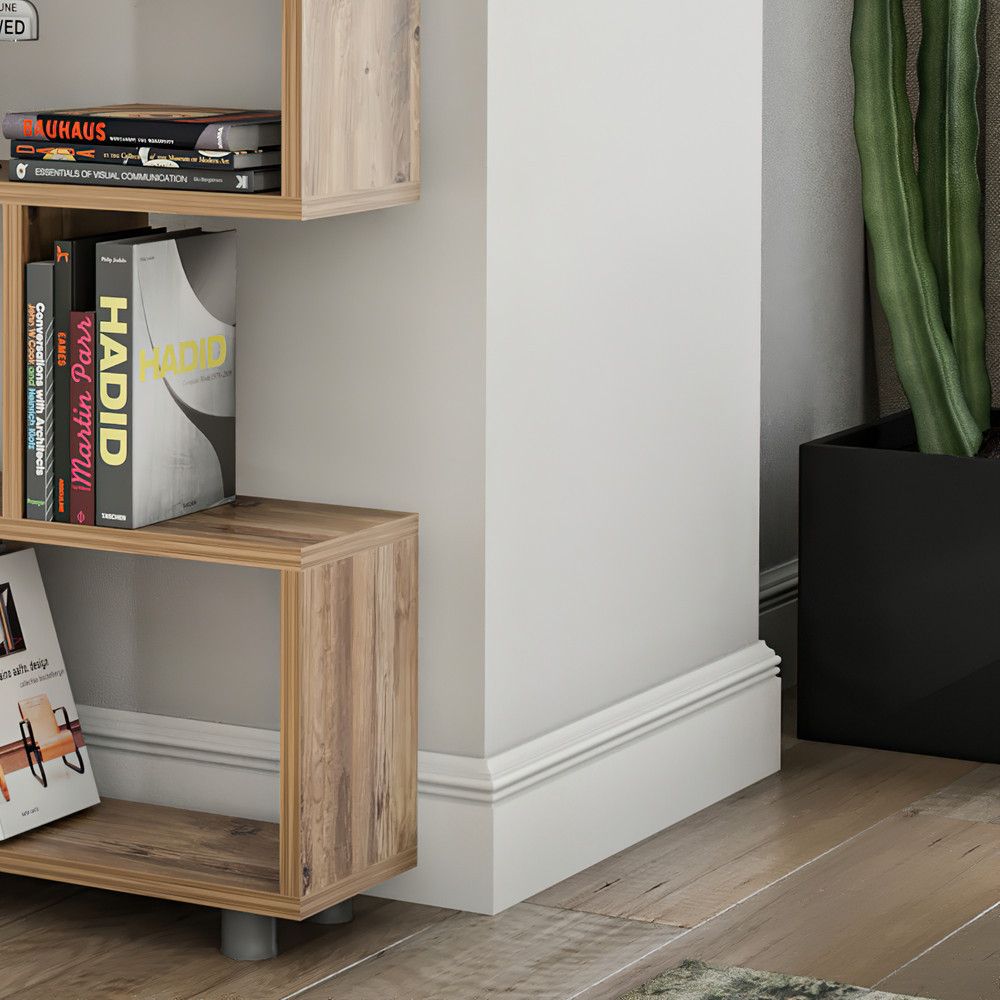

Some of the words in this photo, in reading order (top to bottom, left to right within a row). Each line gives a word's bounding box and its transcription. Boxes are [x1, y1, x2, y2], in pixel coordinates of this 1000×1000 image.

[23, 119, 106, 142] BAUHAUS
[34, 167, 81, 178] ESSENTIALS
[81, 169, 93, 179] OF
[93, 171, 120, 180] VISUAL
[121, 172, 188, 183] COMMUNICATION
[35, 302, 45, 387] Conversations
[57, 332, 67, 366] EAMES
[71, 316, 92, 383] Parr
[139, 334, 227, 382] HADID
[35, 389, 45, 414] with
[100, 295, 128, 466] HADID
[35, 416, 45, 476] Architects
[71, 390, 92, 492] Martin
[0, 669, 12, 682] aino
[29, 657, 49, 671] design
